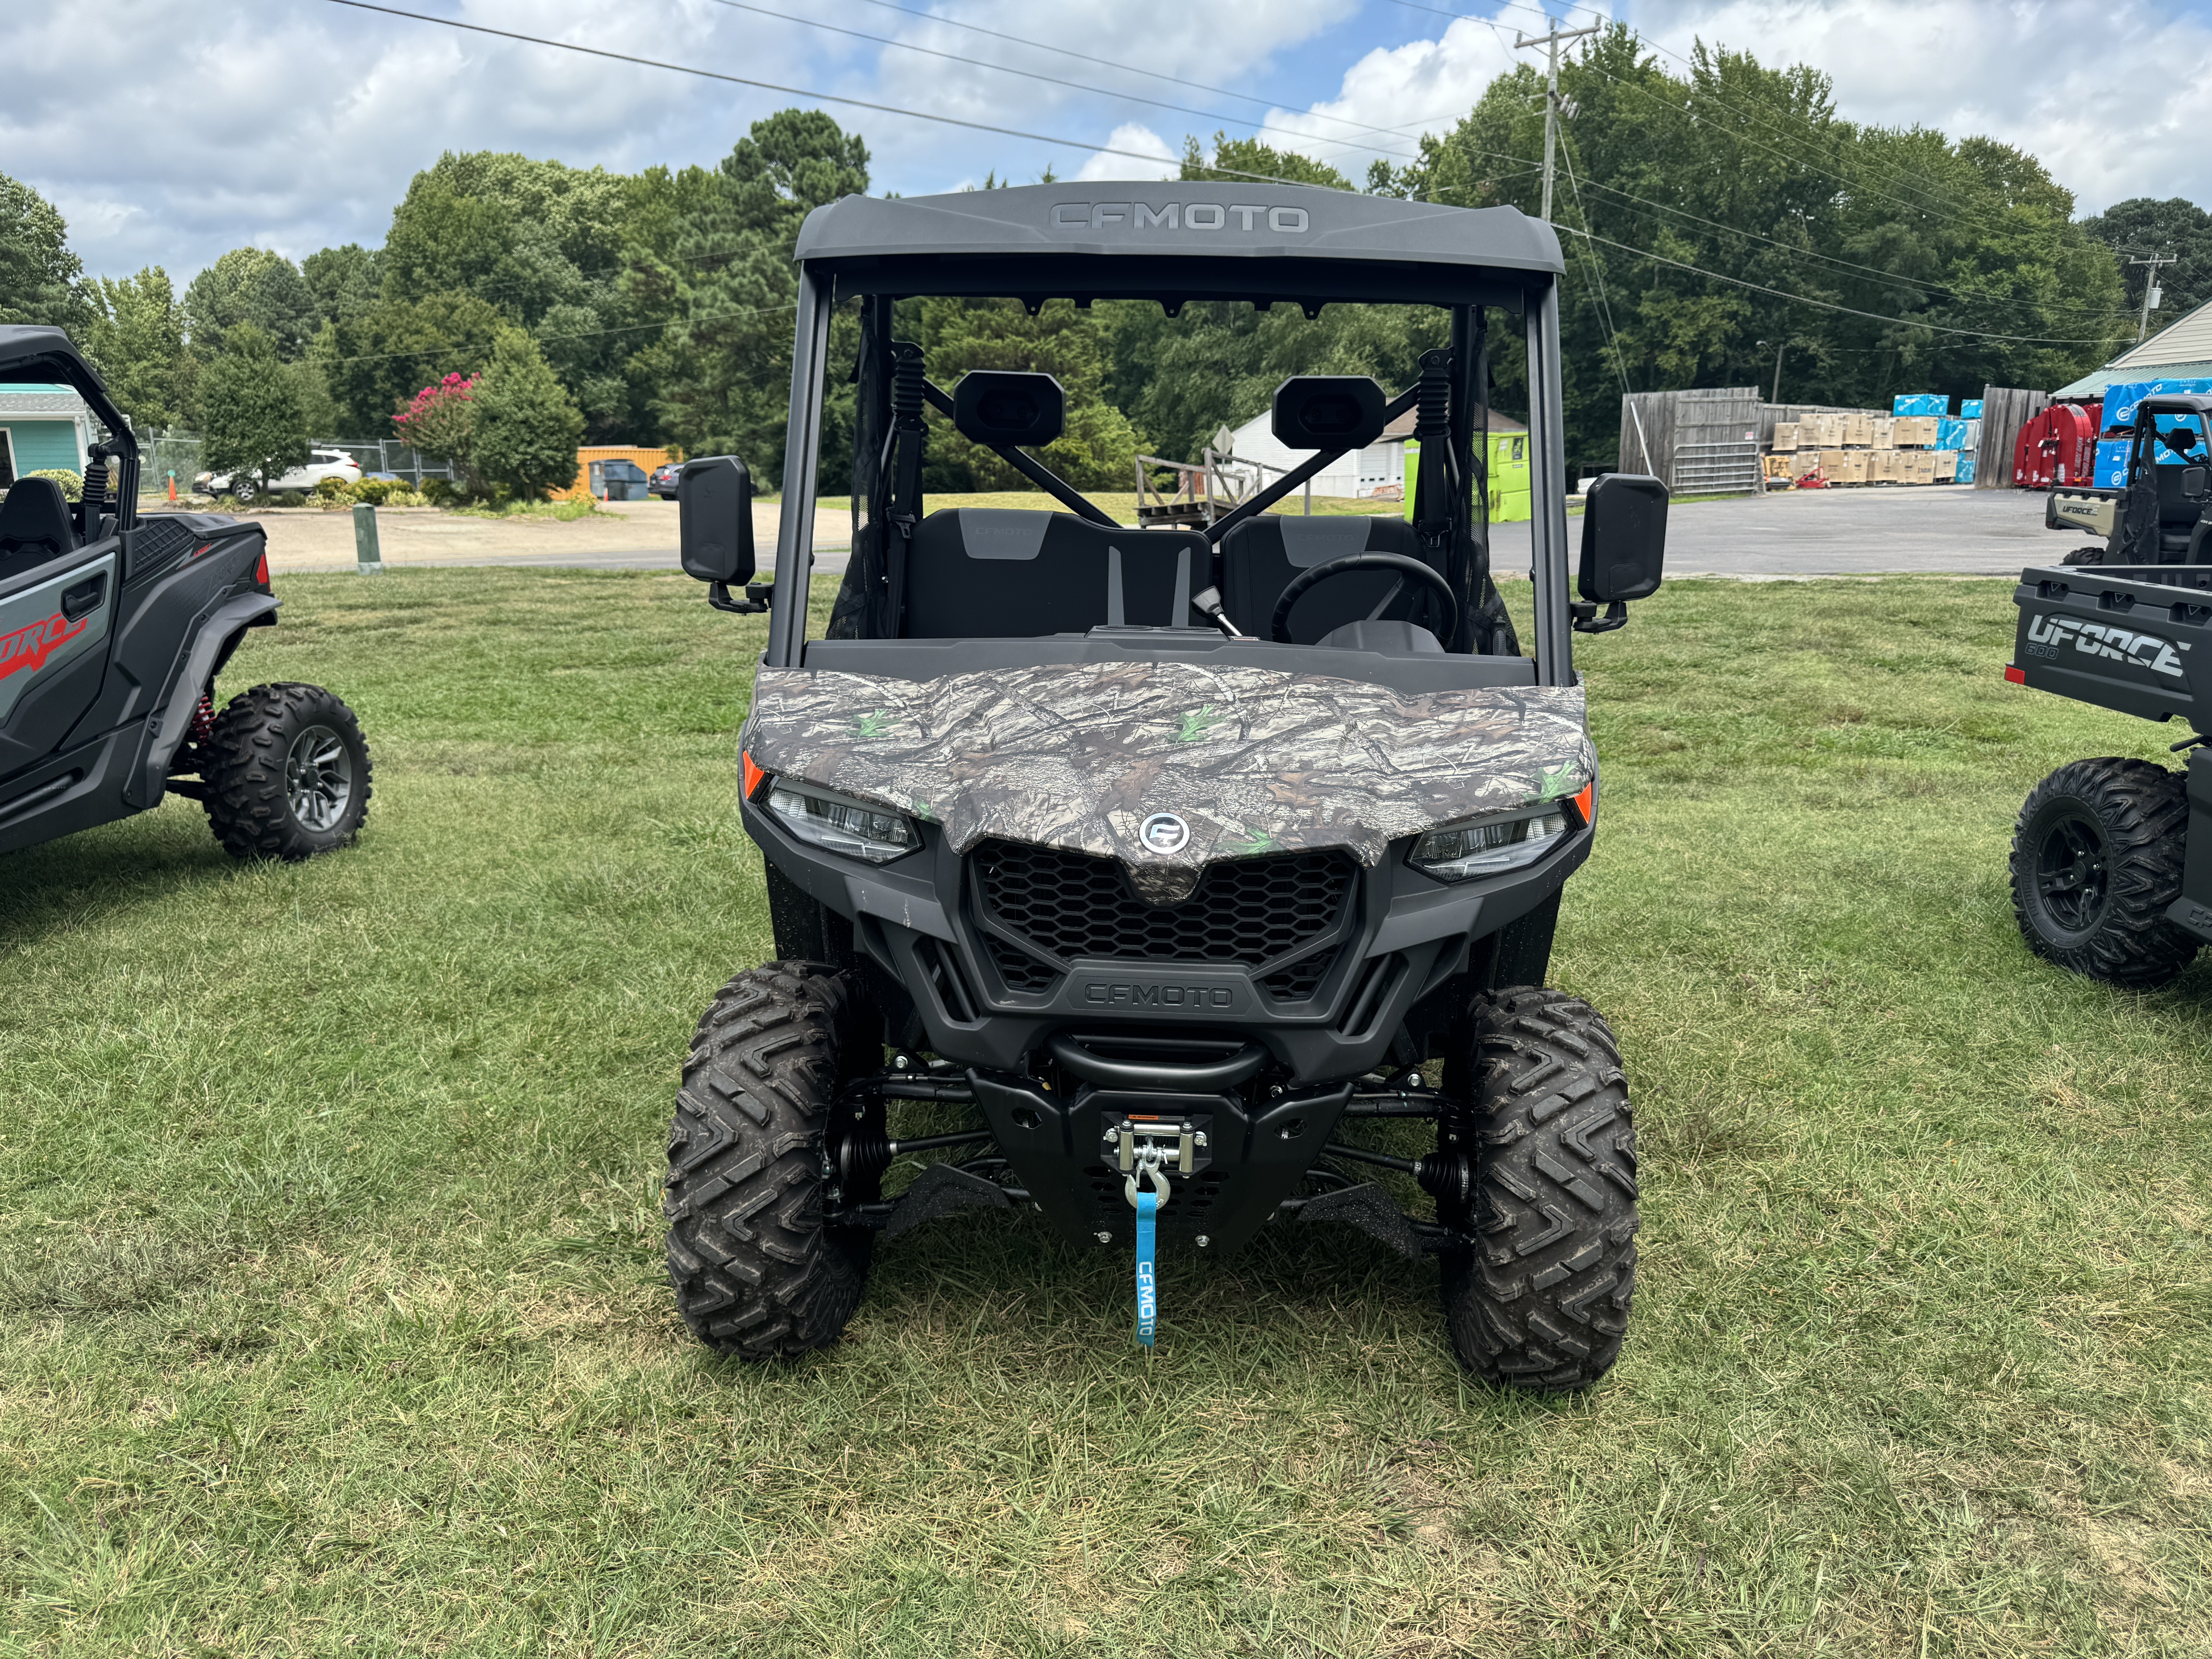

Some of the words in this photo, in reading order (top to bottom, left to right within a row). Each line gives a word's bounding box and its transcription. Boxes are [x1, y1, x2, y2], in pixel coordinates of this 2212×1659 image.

[1050, 202, 1309, 232] CFMOTO
[2063, 505, 2093, 515] UFORCE
[975, 527, 1032, 536] CFMOTO
[1298, 533, 1353, 541] CFMOTO
[2025, 642, 2059, 659] 600
[2028, 614, 2191, 677] UFORCE
[1085, 983, 1233, 1008] CFMOTO
[1139, 1261, 1154, 1336] CFMOTO
